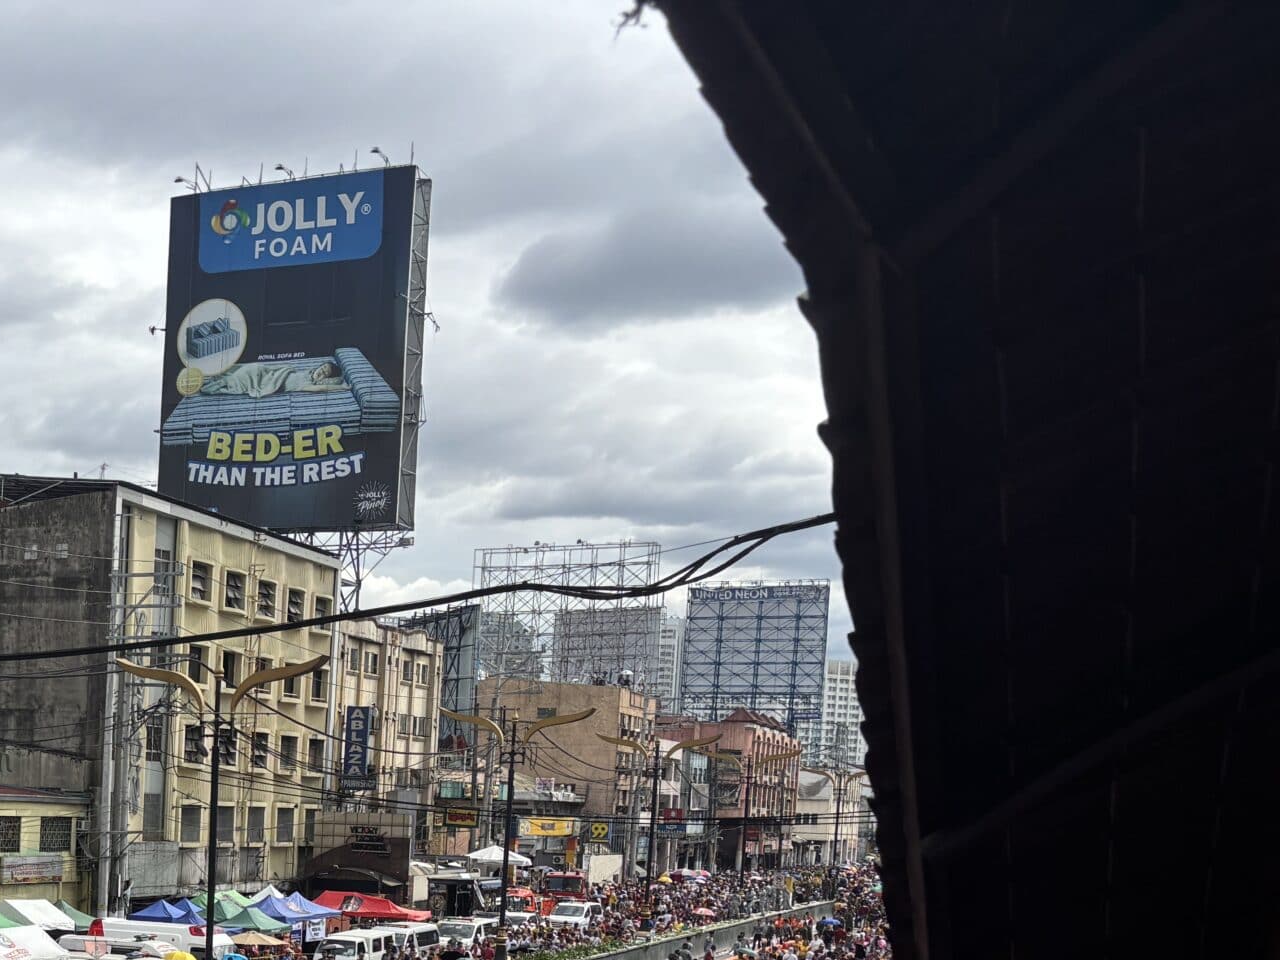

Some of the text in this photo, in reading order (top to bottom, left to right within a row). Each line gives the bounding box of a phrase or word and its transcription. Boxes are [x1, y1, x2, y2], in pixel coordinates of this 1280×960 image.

[251, 191, 365, 236] JOLLY
[254, 232, 333, 260] FOAM
[206, 424, 345, 462] BED-ER
[188, 454, 364, 487] THAN THE REST
[696, 590, 732, 600] UNITED
[735, 588, 769, 600] NEON
[348, 707, 365, 776] ABLAZA
